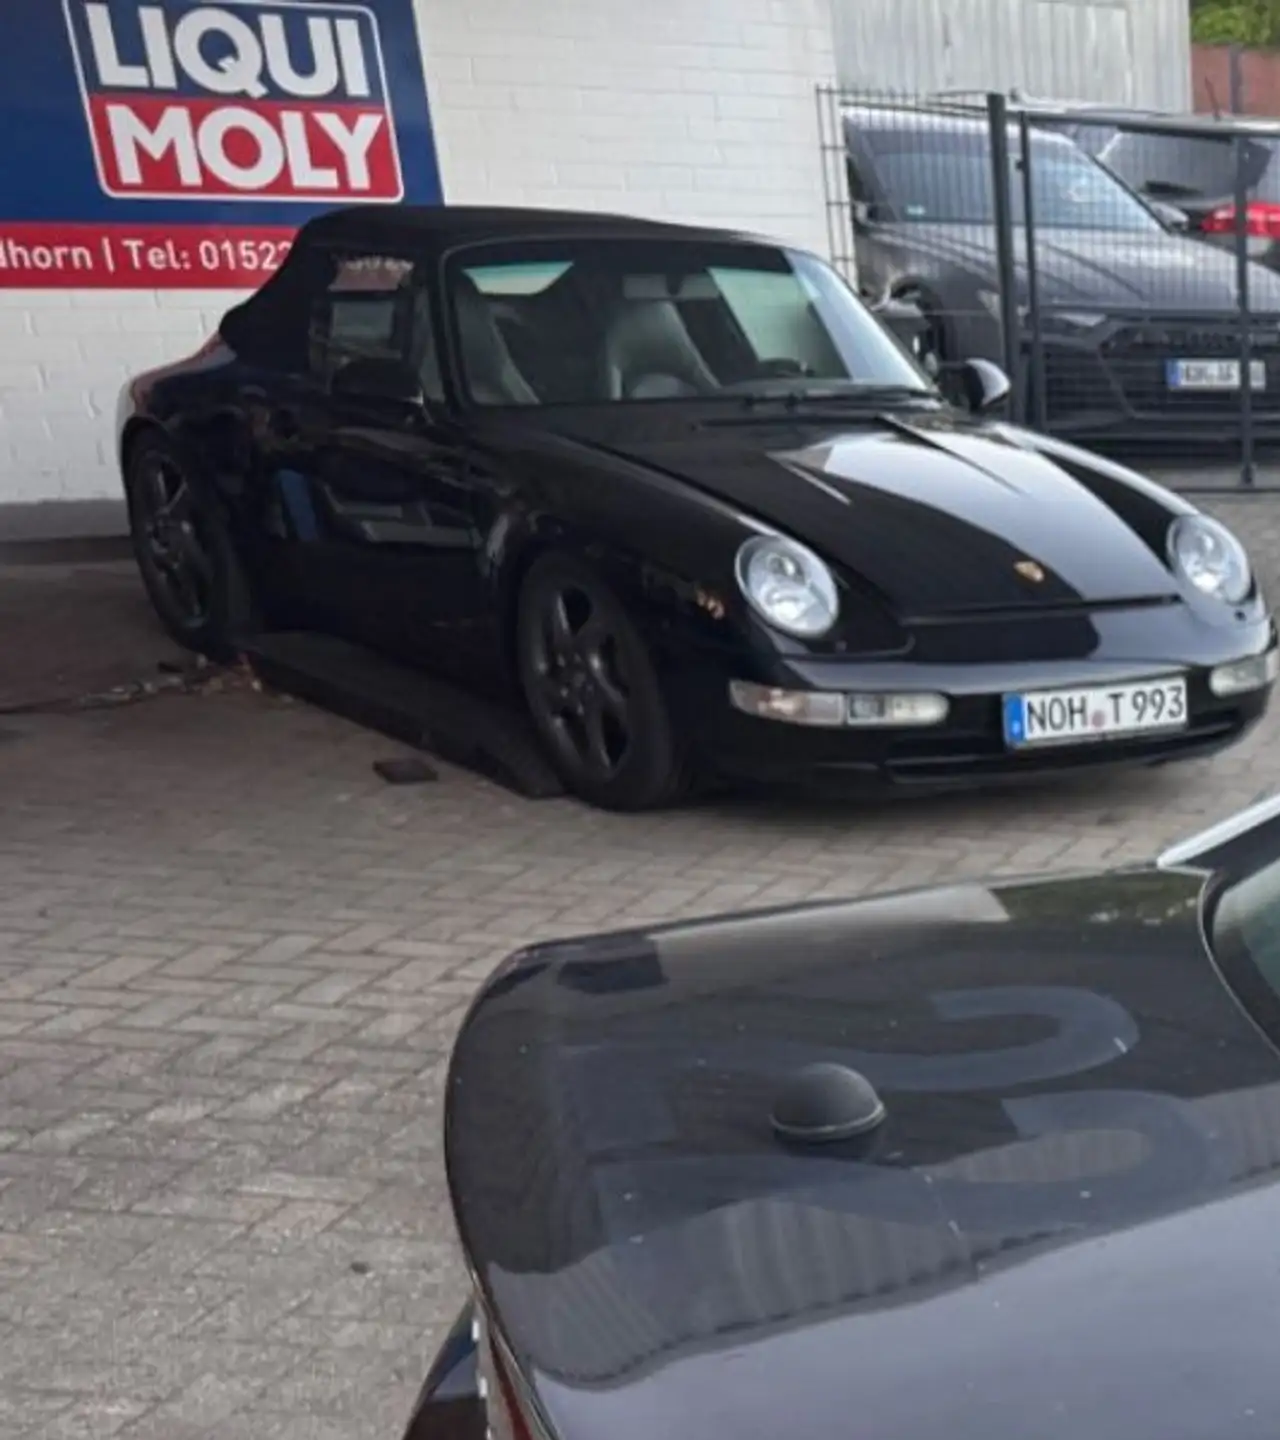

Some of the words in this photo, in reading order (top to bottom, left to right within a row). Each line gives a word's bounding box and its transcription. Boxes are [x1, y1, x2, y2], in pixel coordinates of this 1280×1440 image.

[86, 2, 371, 99] LIQUI
[106, 103, 384, 191] MOLY
[122, 239, 192, 271] Tel:
[1027, 695, 1088, 734] NOH
[1107, 692, 1125, 724] T
[1131, 684, 1184, 722] 993
